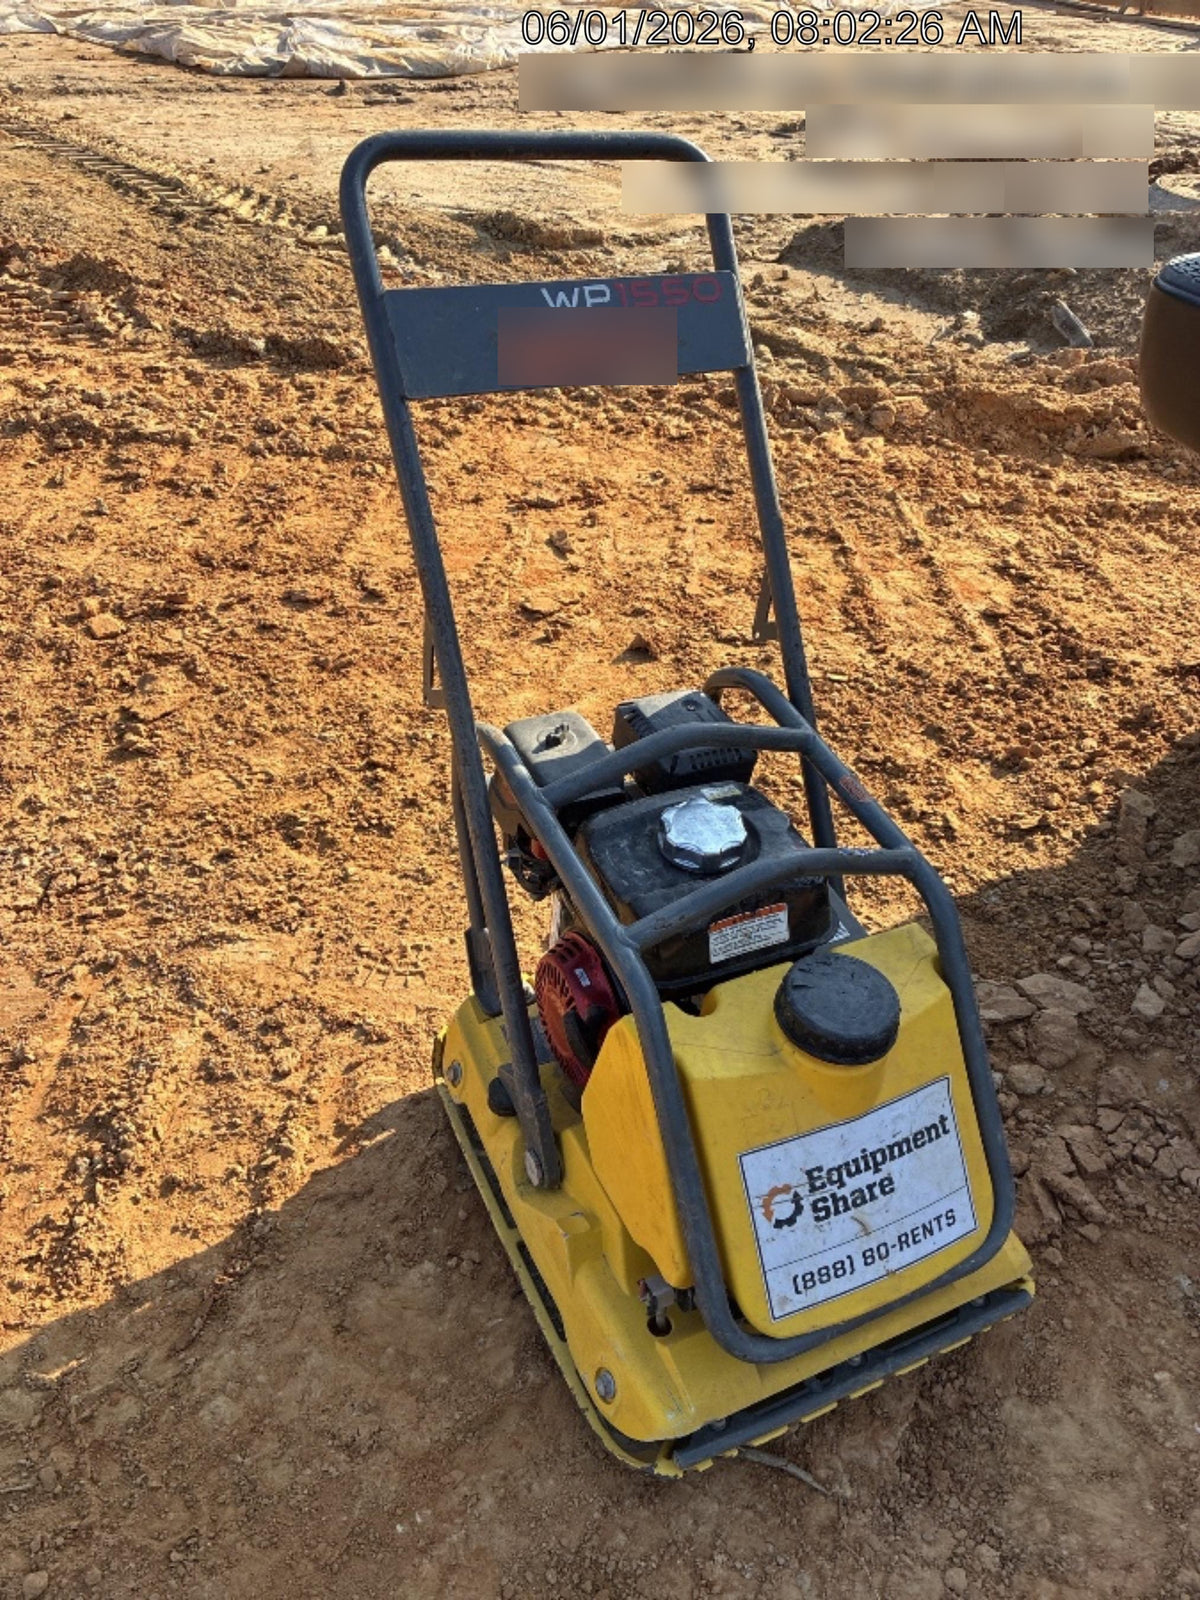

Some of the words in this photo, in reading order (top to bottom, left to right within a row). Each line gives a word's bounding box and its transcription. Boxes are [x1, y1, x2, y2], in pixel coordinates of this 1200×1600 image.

[540, 275, 721, 308] WP1550
[804, 1114, 951, 1194] Equipment
[811, 1175, 896, 1223] Share
[792, 1254, 855, 1295] (888)
[861, 1208, 957, 1267] 80-RENTS
